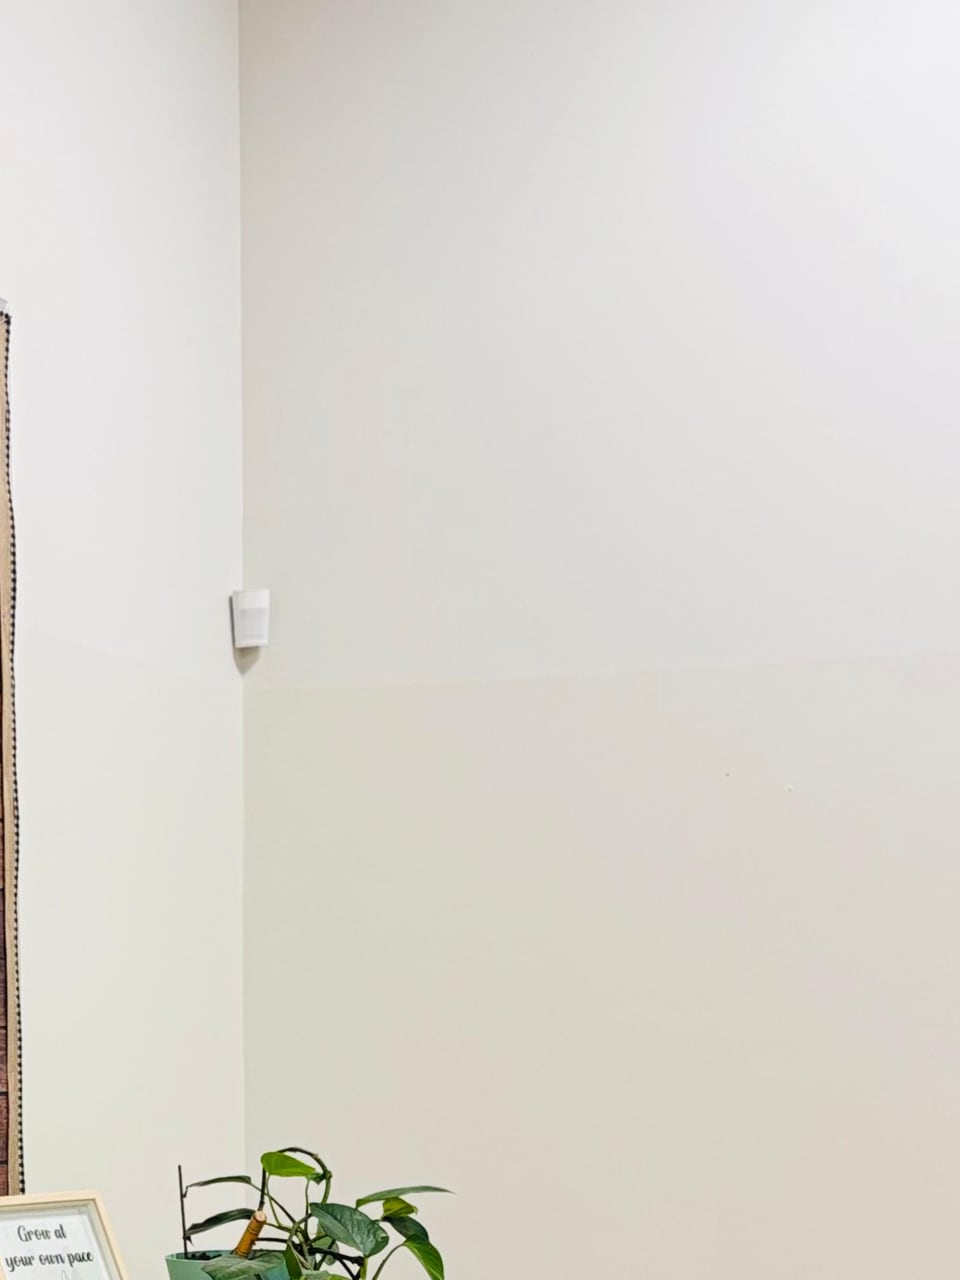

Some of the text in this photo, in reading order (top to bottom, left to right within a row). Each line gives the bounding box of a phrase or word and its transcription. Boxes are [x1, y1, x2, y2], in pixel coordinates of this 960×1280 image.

[17, 1225, 51, 1242] Grow
[5, 1251, 94, 1272] your own pace
